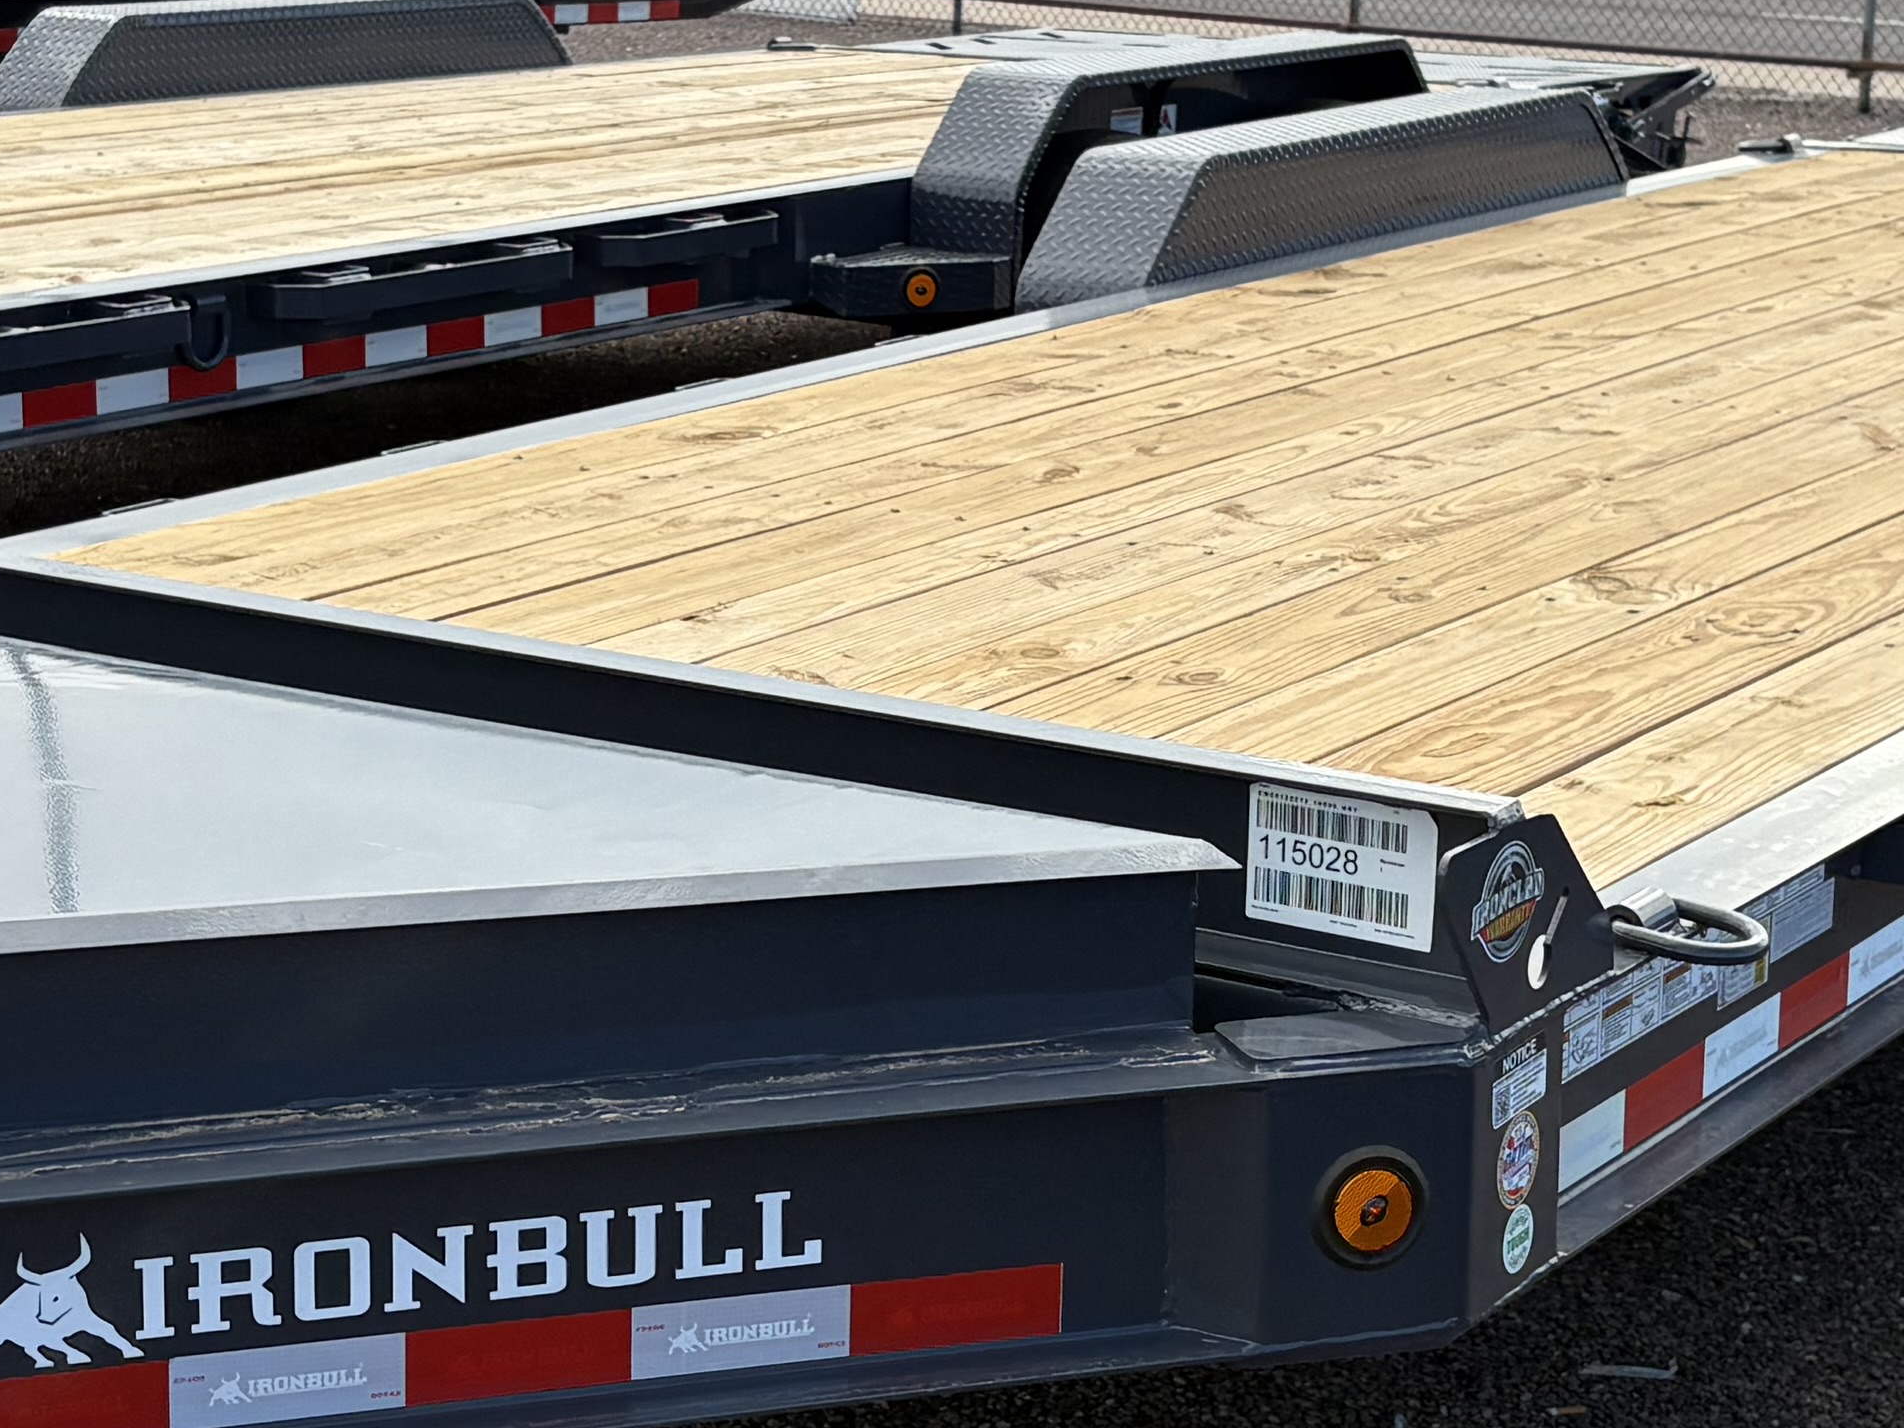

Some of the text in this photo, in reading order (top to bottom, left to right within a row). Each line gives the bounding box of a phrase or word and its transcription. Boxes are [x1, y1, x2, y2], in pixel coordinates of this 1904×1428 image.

[1259, 833, 1359, 876] 115028
[1502, 1037, 1538, 1074] NOTICE
[133, 1190, 824, 1341] IRONBULL
[703, 1319, 815, 1346] IRONBULL
[247, 1368, 368, 1397] IRONBULL
